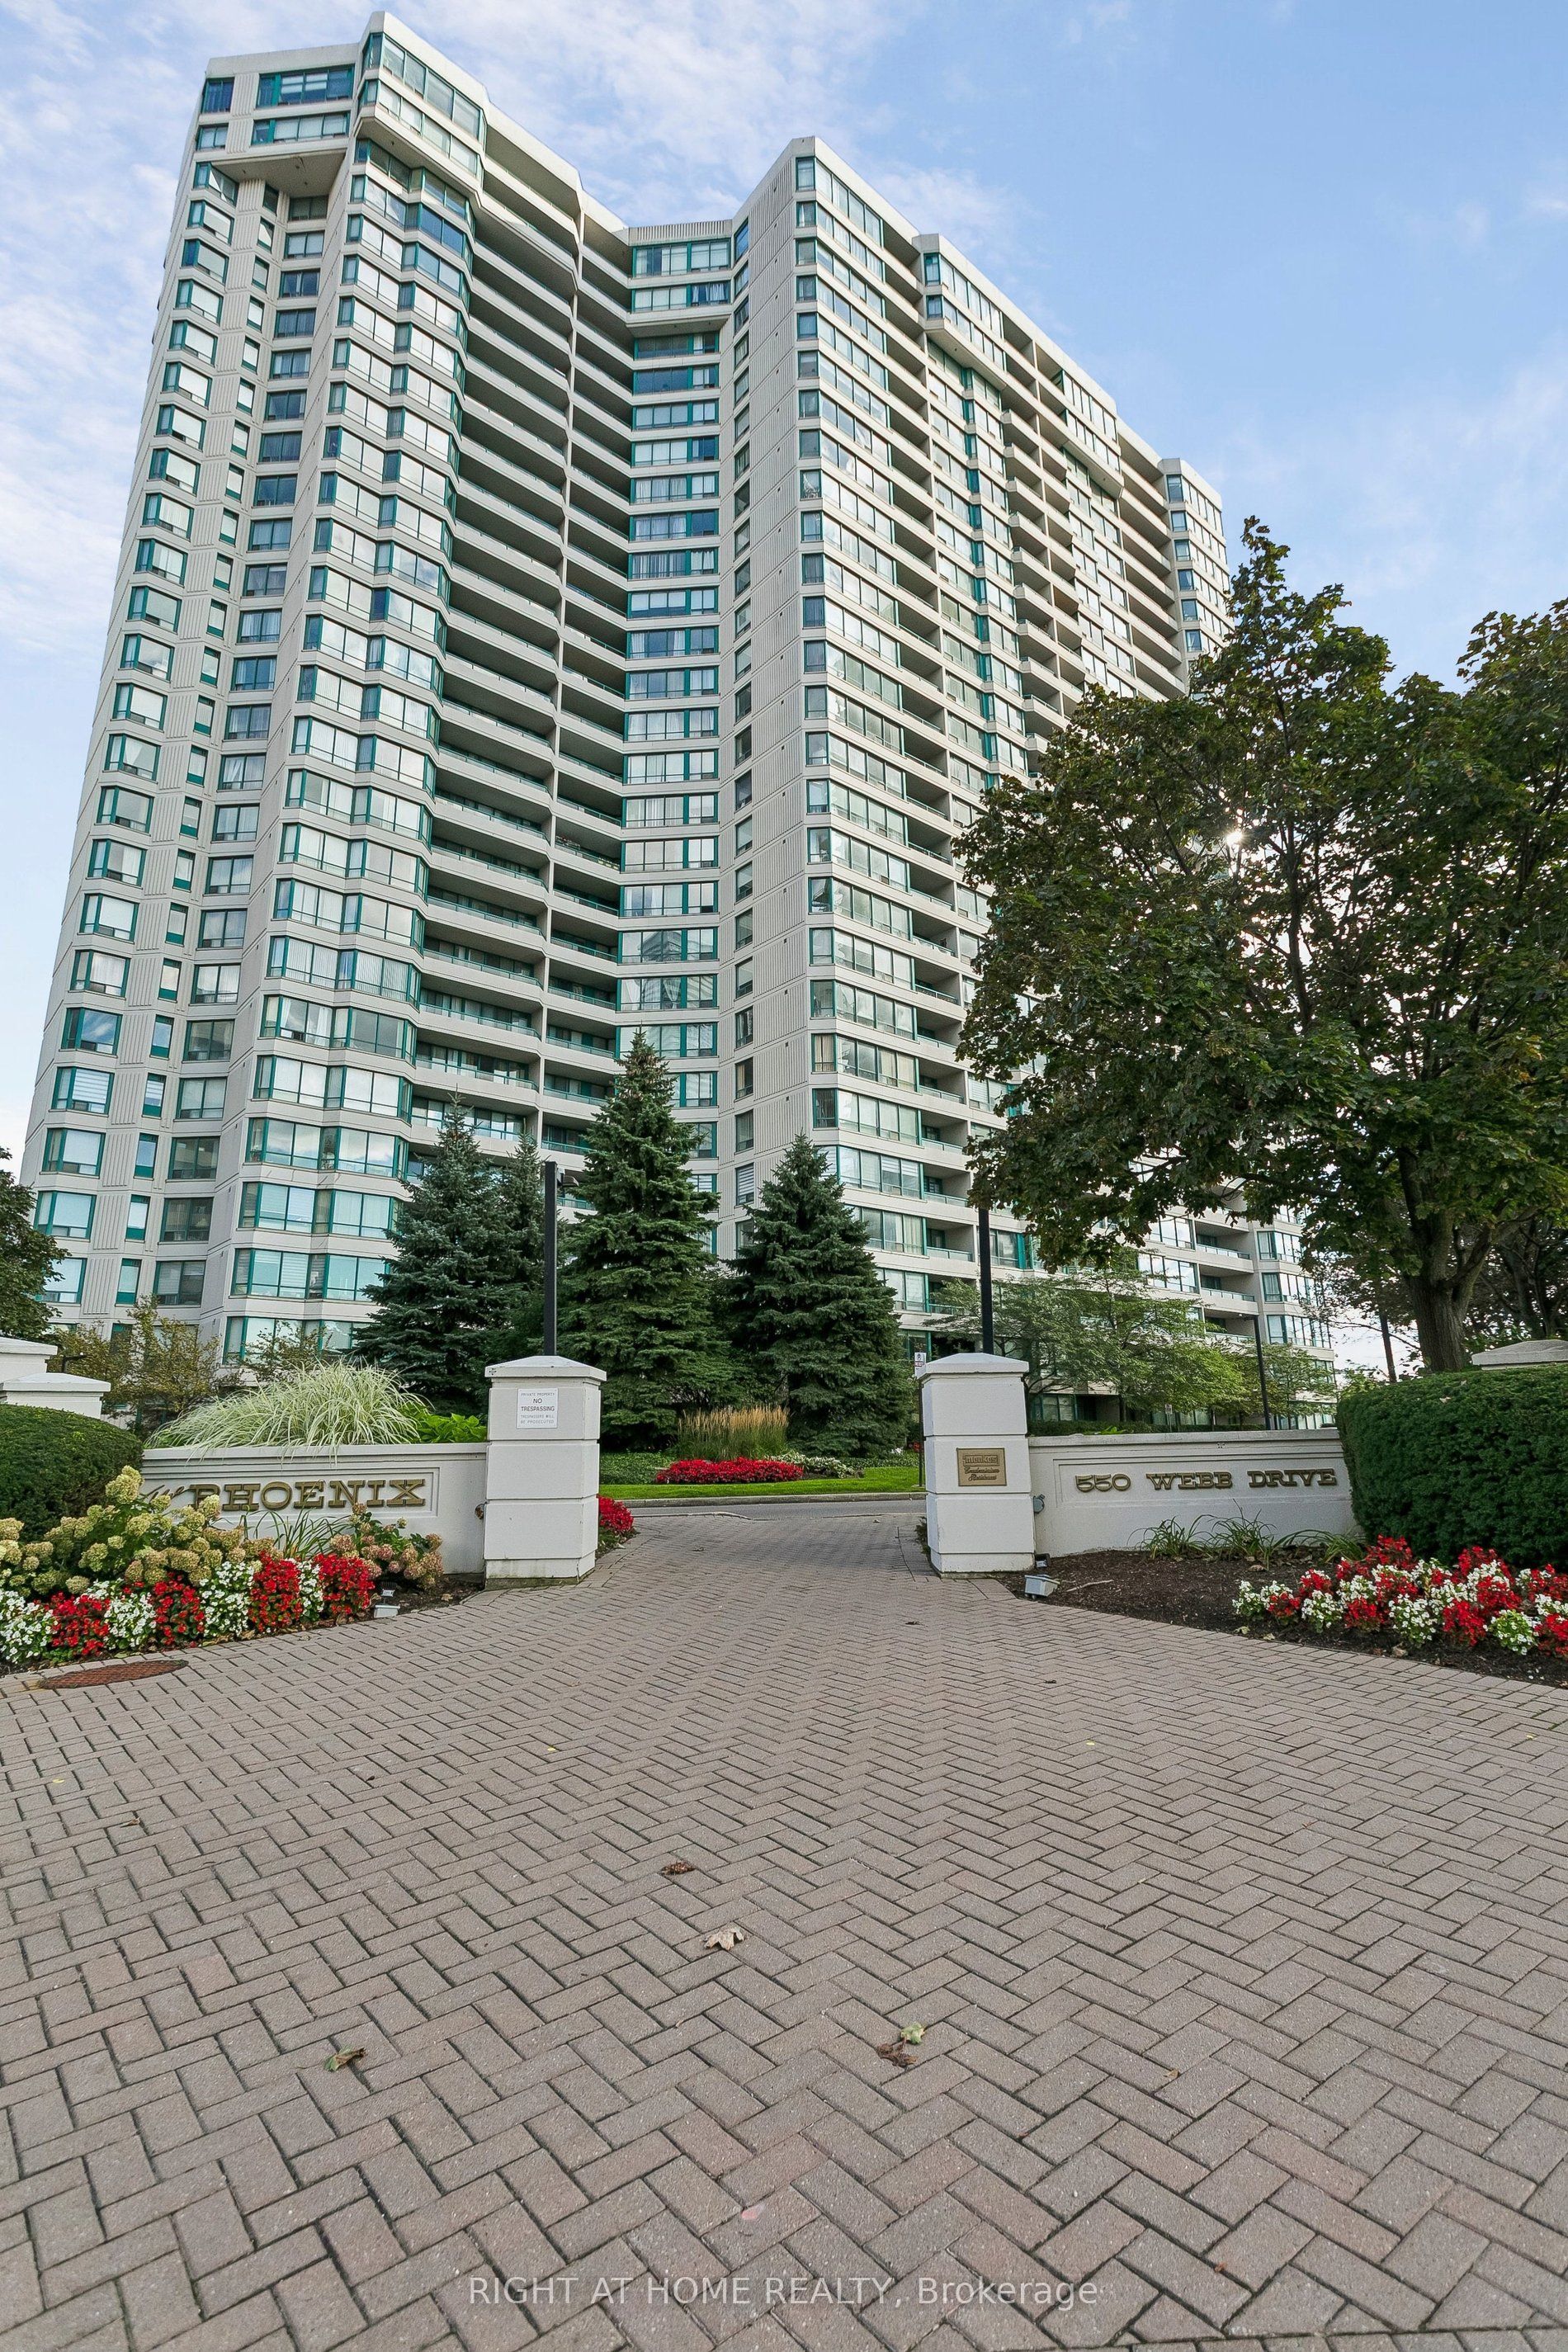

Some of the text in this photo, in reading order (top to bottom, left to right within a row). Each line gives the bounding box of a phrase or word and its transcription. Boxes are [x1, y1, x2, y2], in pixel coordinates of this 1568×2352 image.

[1075, 1468, 1338, 1492] 550 WEBB DRIVE
[188, 1478, 426, 1511] PHOENIX
